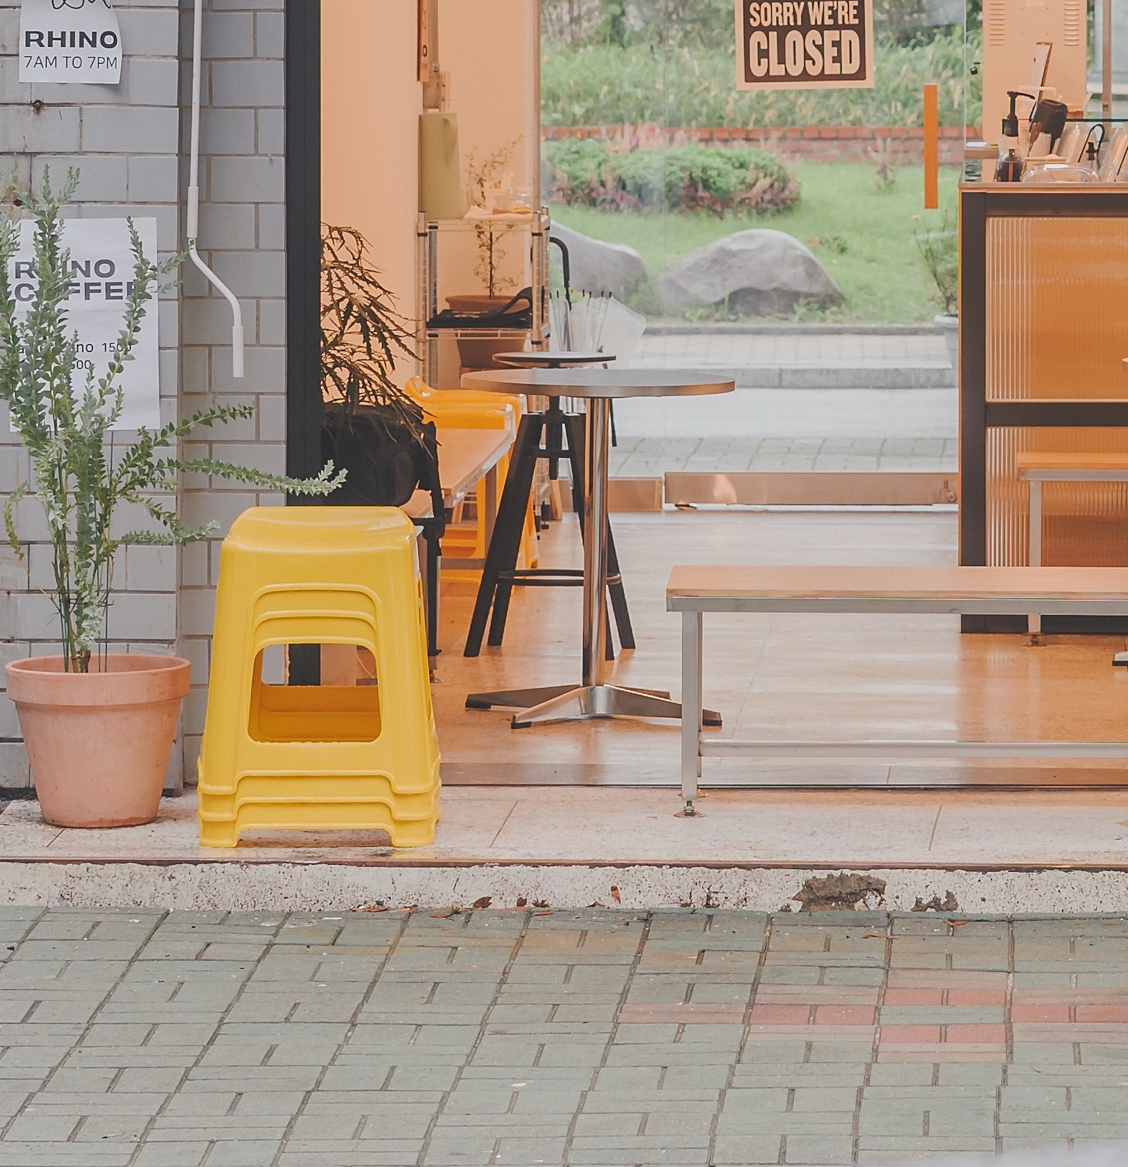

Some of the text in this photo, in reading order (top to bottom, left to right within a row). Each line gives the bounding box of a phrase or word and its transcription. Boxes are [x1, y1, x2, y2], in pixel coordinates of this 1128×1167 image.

[749, 0, 860, 27] SORRY WE'RE
[24, 30, 118, 48] RHINO
[24, 55, 118, 69] 7AM TO 7PM
[749, 29, 861, 77] CLOSED
[14, 259, 116, 279] RINO
[14, 281, 138, 302] CFFE
